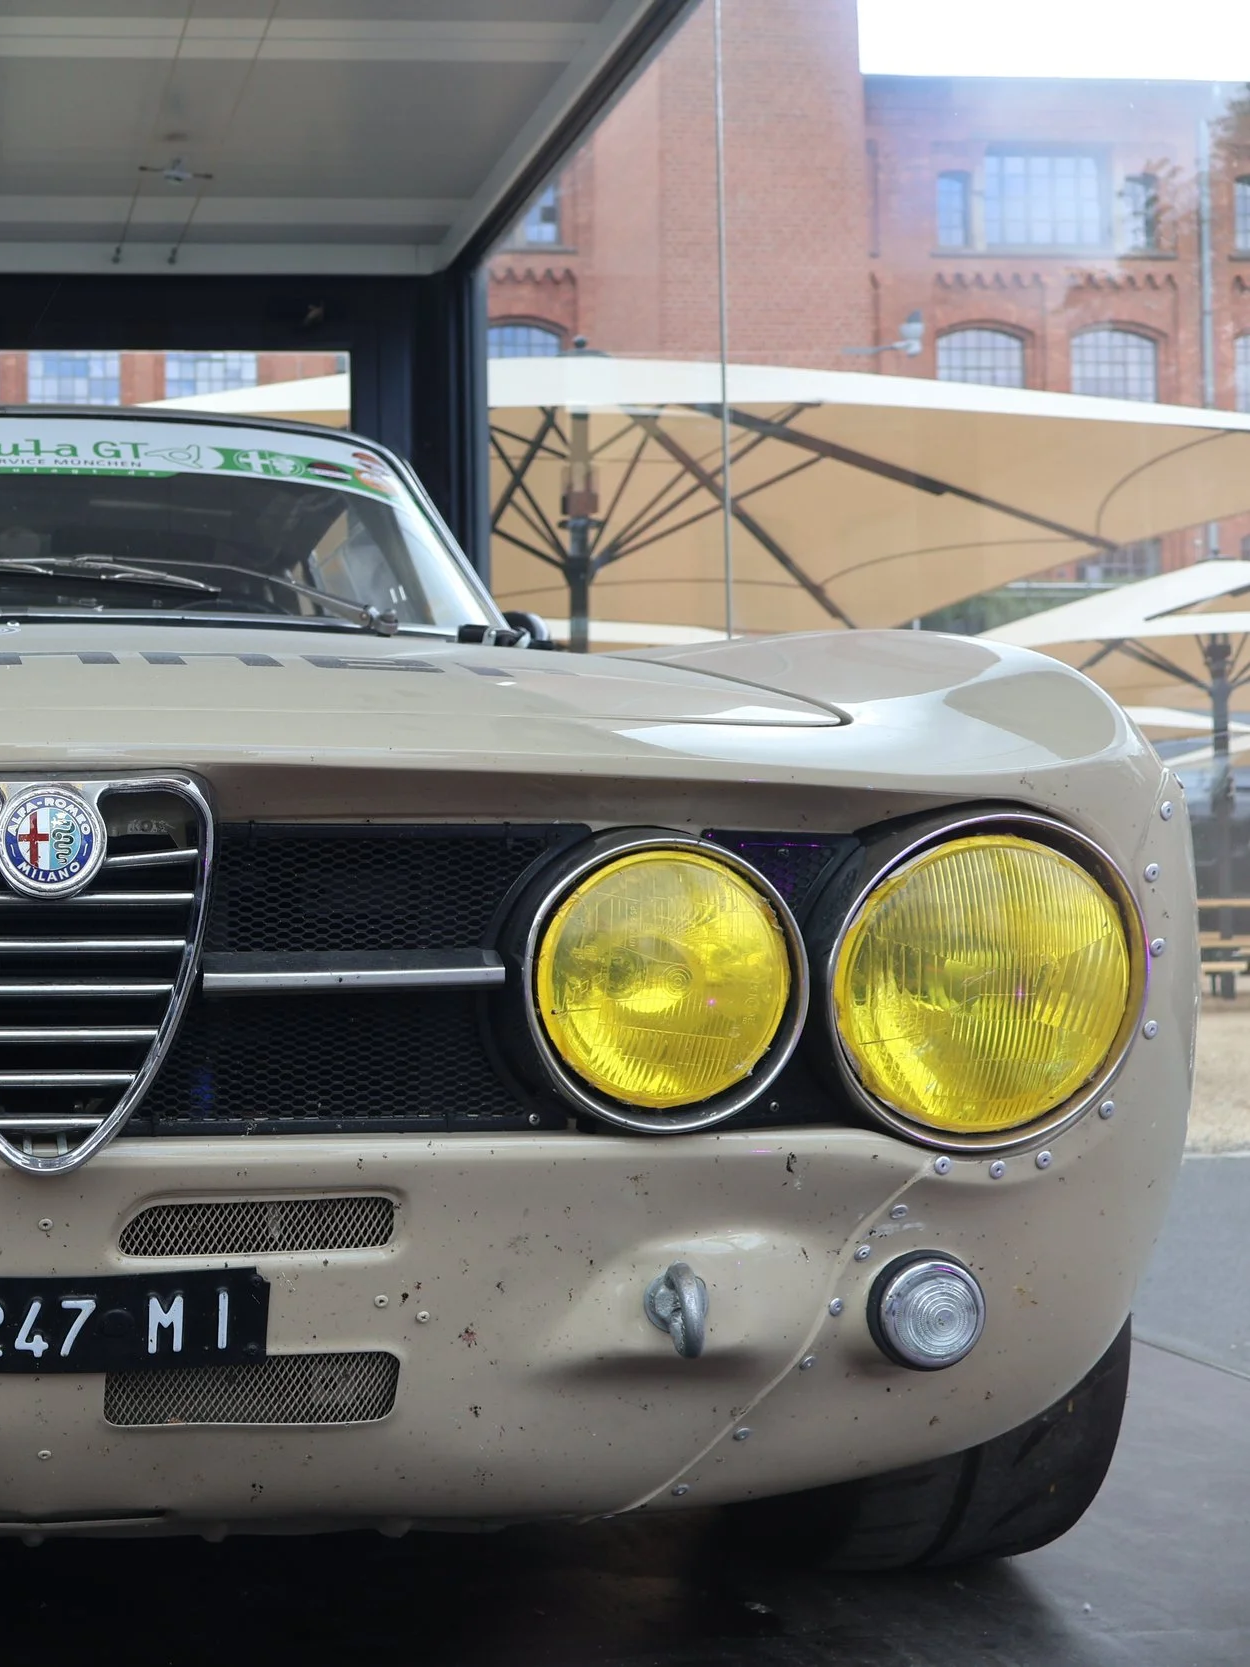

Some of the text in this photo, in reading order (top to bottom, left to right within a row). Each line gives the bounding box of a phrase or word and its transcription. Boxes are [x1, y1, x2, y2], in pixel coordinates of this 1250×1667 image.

[93, 440, 149, 459] GT
[7, 797, 91, 837] ALFA-ROMEO
[17, 861, 81, 882] MILANO
